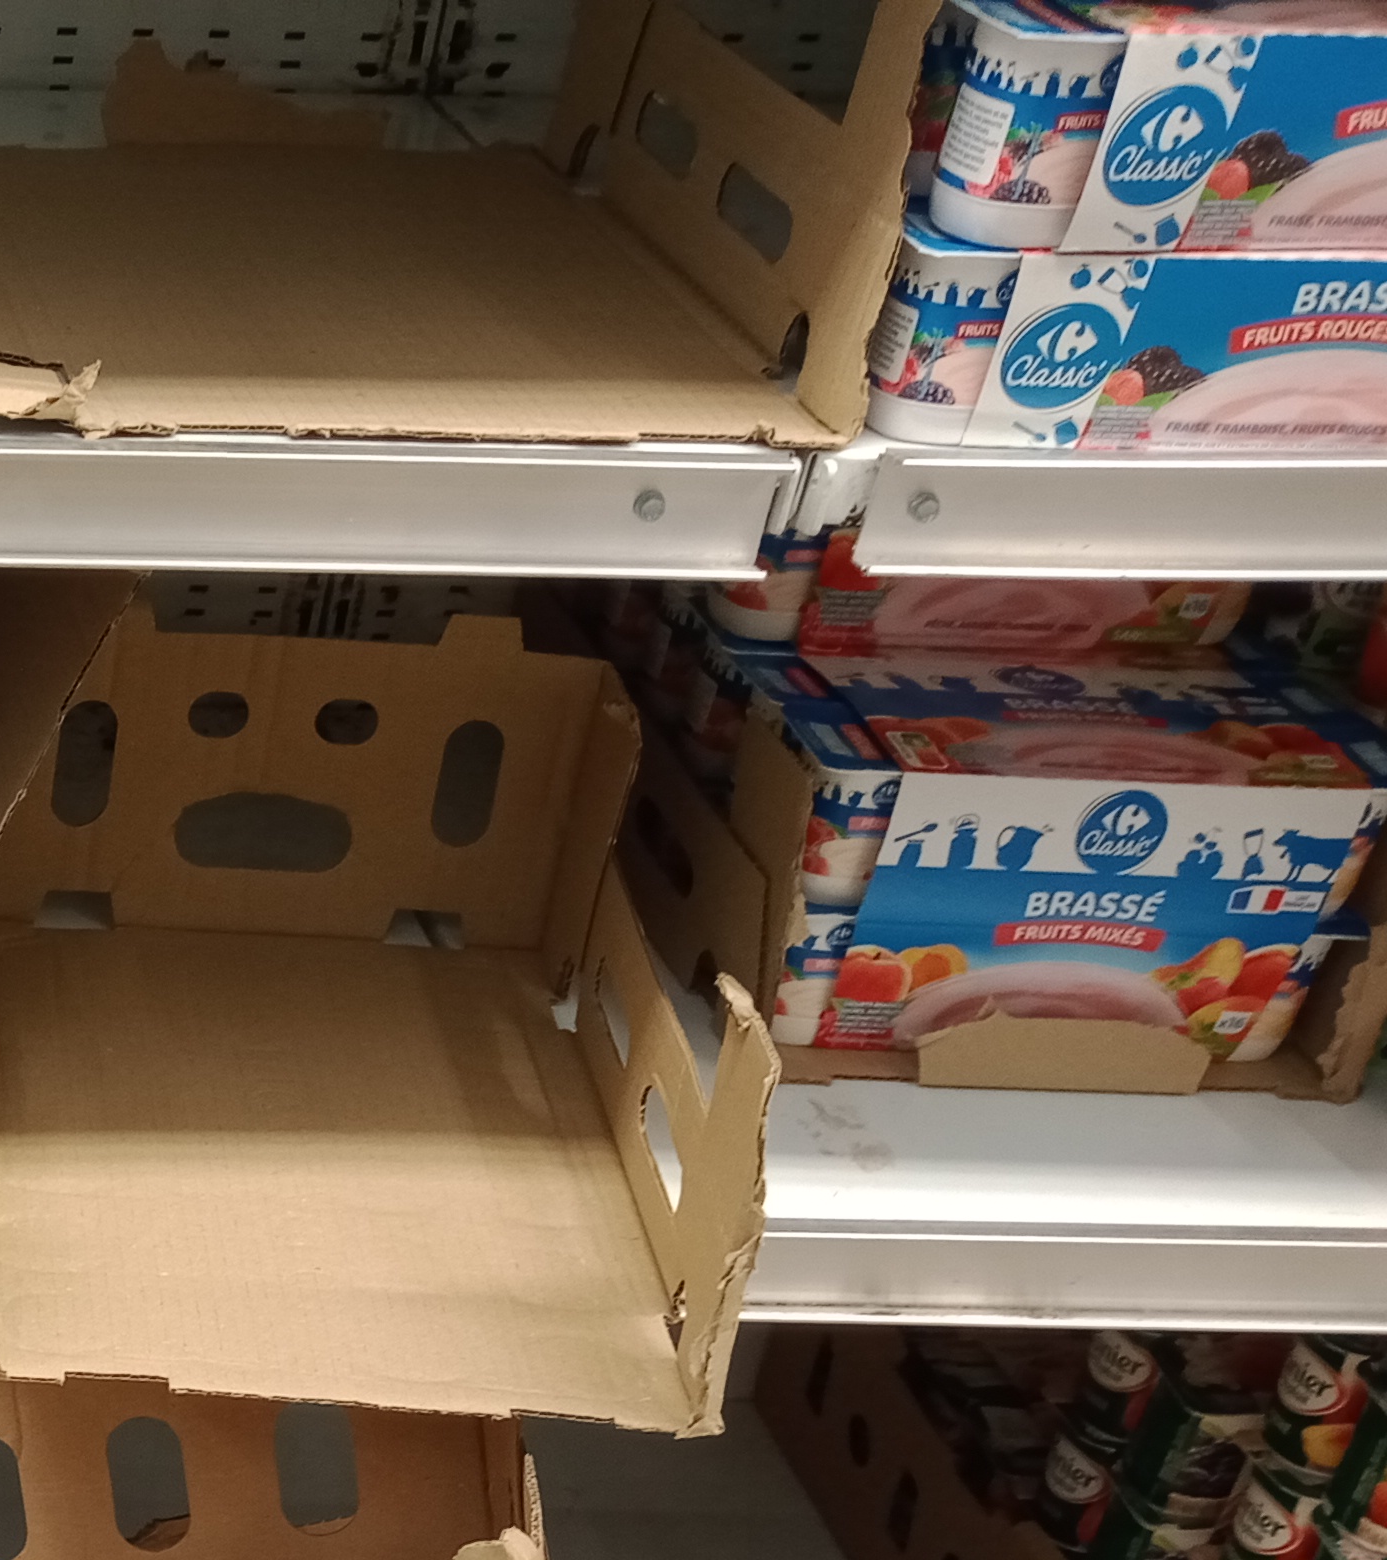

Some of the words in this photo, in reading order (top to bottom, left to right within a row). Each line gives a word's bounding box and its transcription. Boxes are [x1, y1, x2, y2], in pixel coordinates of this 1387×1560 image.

[1291, 281, 1387, 315] BRAS
[1243, 321, 1316, 349] FRUITS
[1025, 890, 1166, 923] BRASSÉ
[1013, 926, 1083, 943] FRUITS
